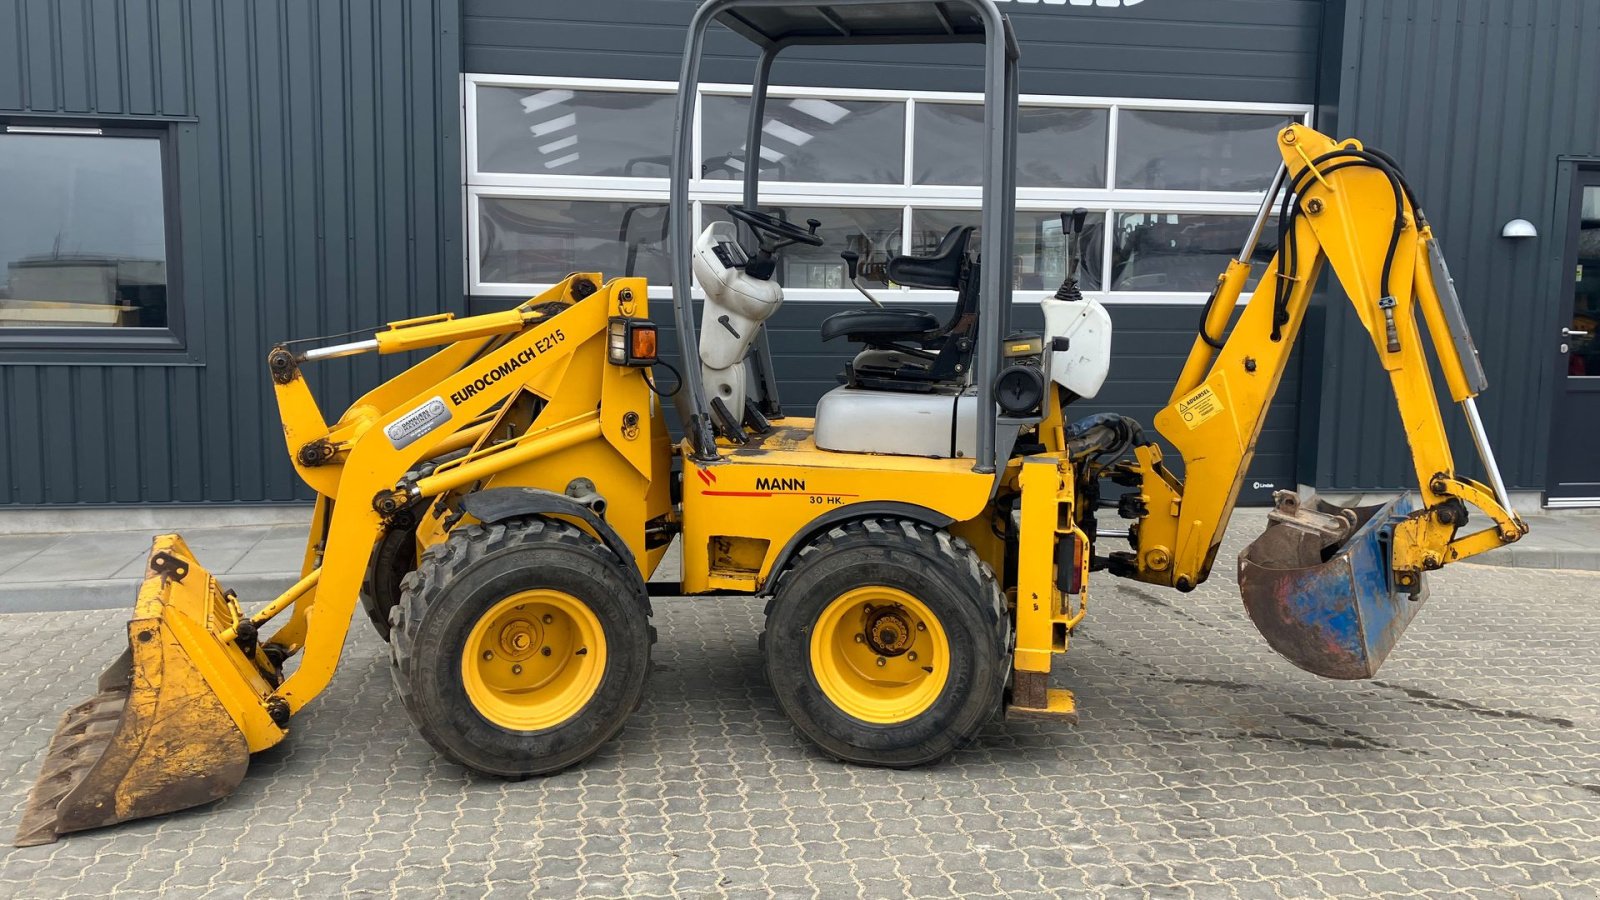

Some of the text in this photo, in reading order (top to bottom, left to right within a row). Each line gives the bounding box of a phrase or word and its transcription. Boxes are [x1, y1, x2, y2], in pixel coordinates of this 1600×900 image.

[450, 329, 565, 406] EUROCOMACH E215
[1186, 389, 1210, 406] ADVARSEL
[756, 478, 805, 490] MANN
[809, 496, 845, 505] 30 HK.
